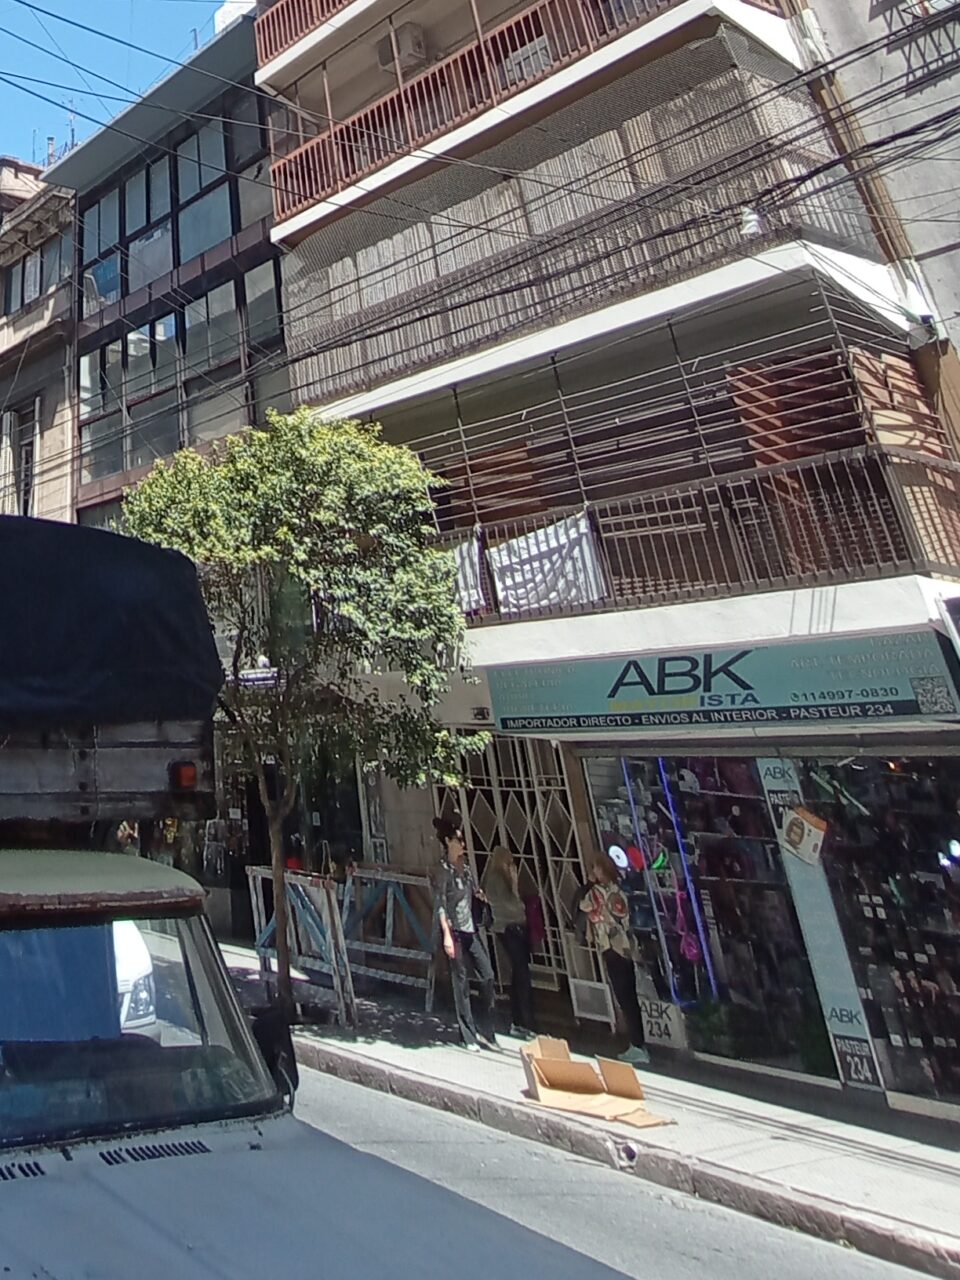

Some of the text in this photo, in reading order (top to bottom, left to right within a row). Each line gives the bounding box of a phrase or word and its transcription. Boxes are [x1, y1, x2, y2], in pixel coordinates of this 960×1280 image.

[607, 649, 756, 698] ABK
[507, 717, 578, 729] IMPORTADOR
[580, 715, 632, 726] DIRECTO
[642, 713, 690, 726] ENVIOS
[692, 713, 706, 723] AL
[712, 709, 777, 722] INTERIOR
[791, 705, 863, 719] PASTEUR
[867, 703, 894, 716] 234
[763, 766, 792, 780] ABK
[640, 1000, 672, 1021] ABK
[829, 1007, 861, 1025] ABK
[646, 1019, 672, 1040] 234
[836, 1038, 872, 1056] PASTEUR
[846, 1054, 873, 1082] 234
